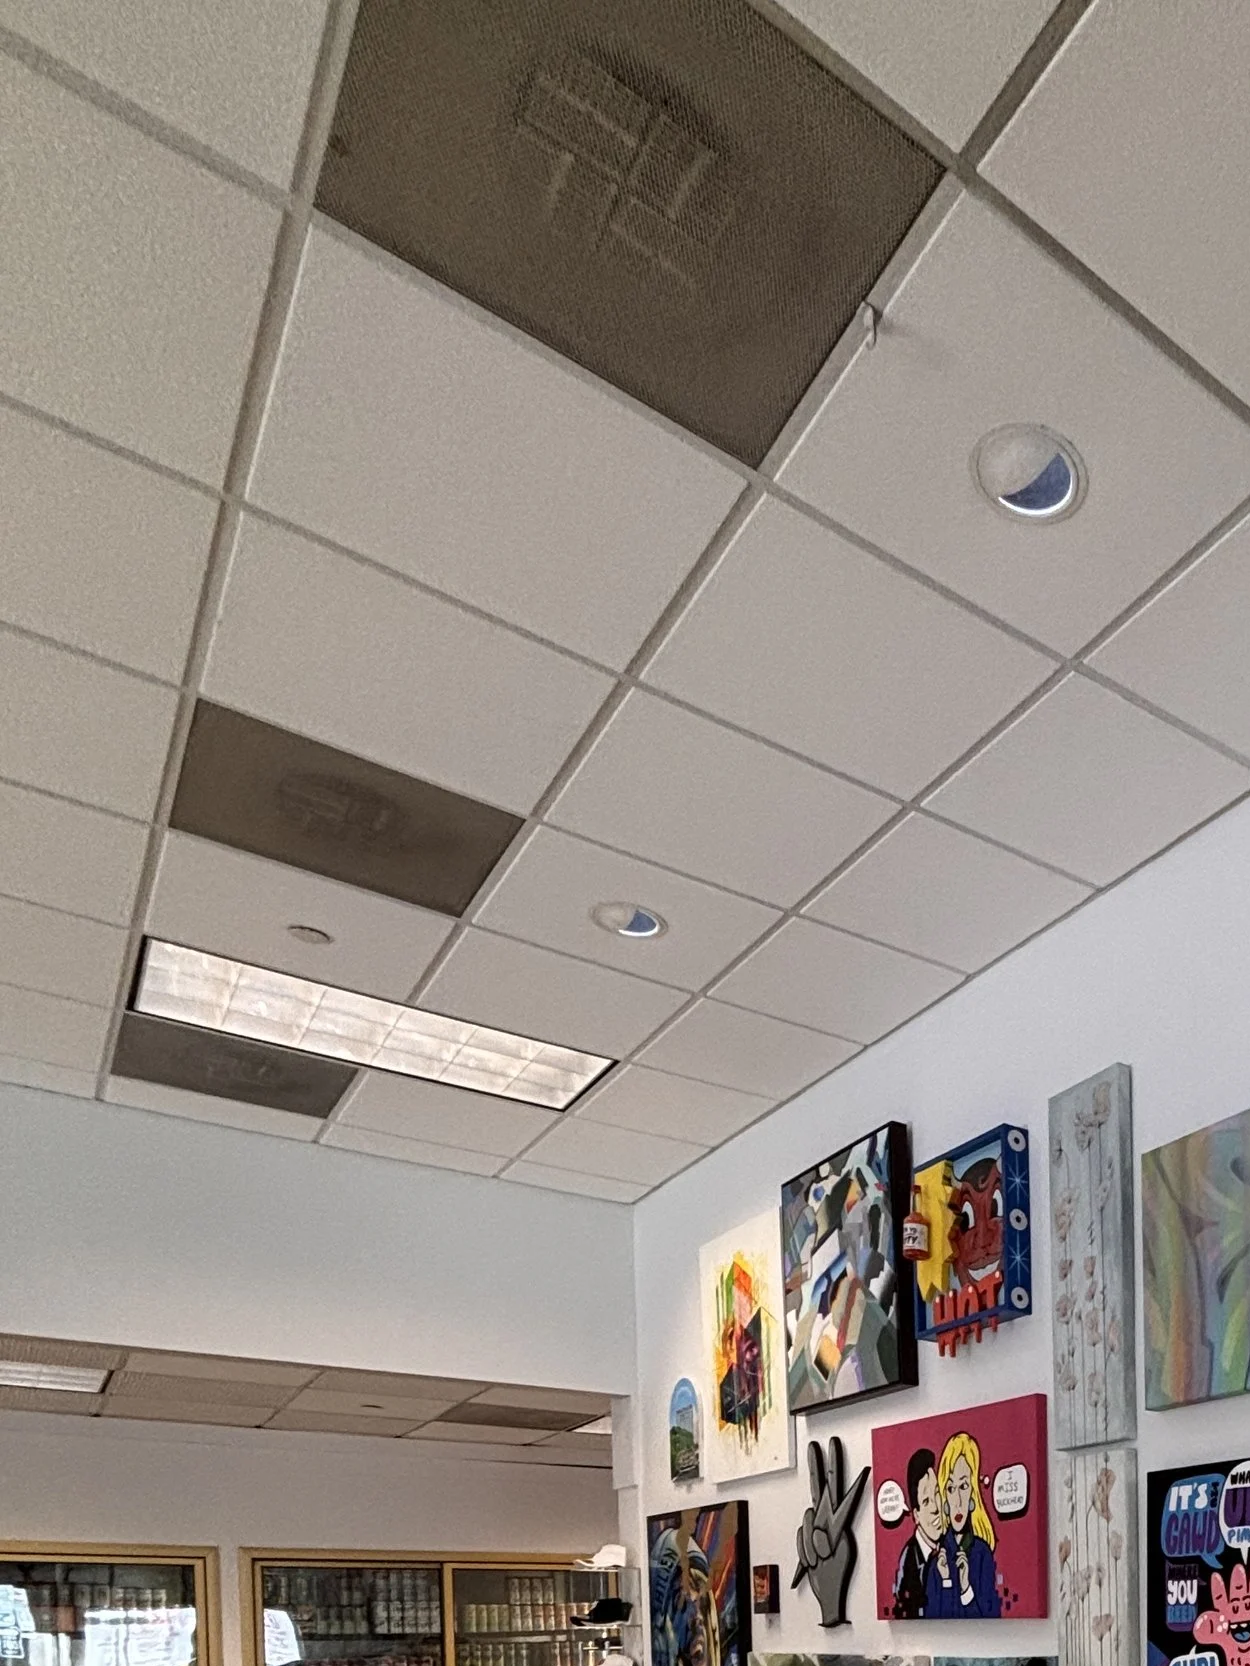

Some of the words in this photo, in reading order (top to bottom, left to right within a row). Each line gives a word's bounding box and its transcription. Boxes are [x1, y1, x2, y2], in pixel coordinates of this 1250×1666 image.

[932, 1270, 1003, 1357] HOT
[998, 1481, 1018, 1494] MISS
[1168, 1482, 1208, 1511] IT'S
[1164, 1511, 1220, 1555] GAWD
[1167, 1579, 1198, 1605] YOU
